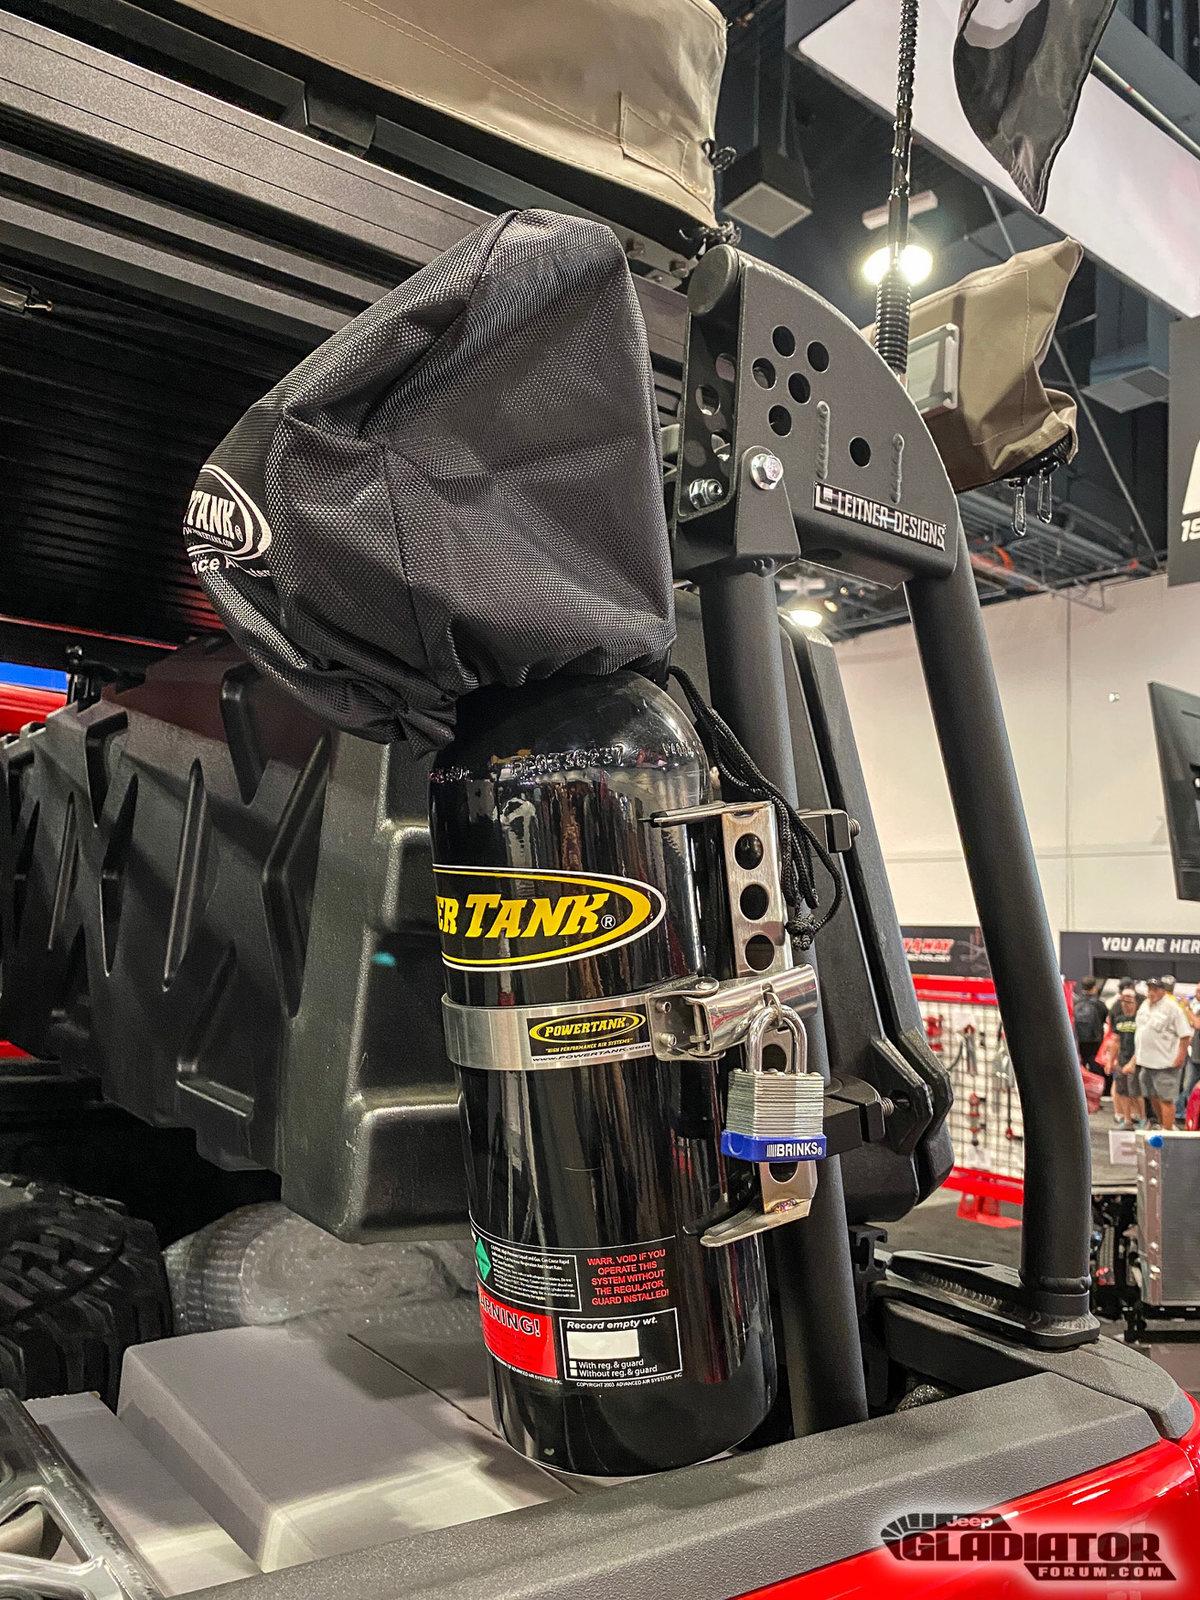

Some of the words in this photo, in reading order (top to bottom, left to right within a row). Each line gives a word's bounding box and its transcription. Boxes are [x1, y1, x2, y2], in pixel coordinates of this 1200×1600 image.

[837, 491, 889, 530] LEITNER
[893, 511, 946, 549] DESIGNS
[1102, 937, 1131, 951] YOU
[1134, 938, 1167, 953] ARE
[587, 1257, 615, 1265] WARR.
[616, 1254, 637, 1263] VOID
[639, 1252, 647, 1260] IF
[648, 1249, 666, 1259] YOU
[598, 1264, 637, 1275] OPERATE
[638, 1261, 657, 1271] THIS
[591, 1276, 626, 1285] SYSTEM
[627, 1269, 665, 1282] WITHOUT
[595, 1287, 611, 1295] THE
[614, 1280, 664, 1293] REGULATOR
[591, 1297, 621, 1305] GUARD
[623, 1289, 669, 1303] INSTALLED!
[566, 1321, 604, 1329] Record
[606, 1319, 640, 1329] empty
[642, 1316, 658, 1325] wt.
[578, 1361, 596, 1369] With
[598, 1362, 613, 1370] reg.
[621, 1359, 644, 1369] guard
[579, 1369, 610, 1377] Without
[634, 1365, 658, 1376] guard
